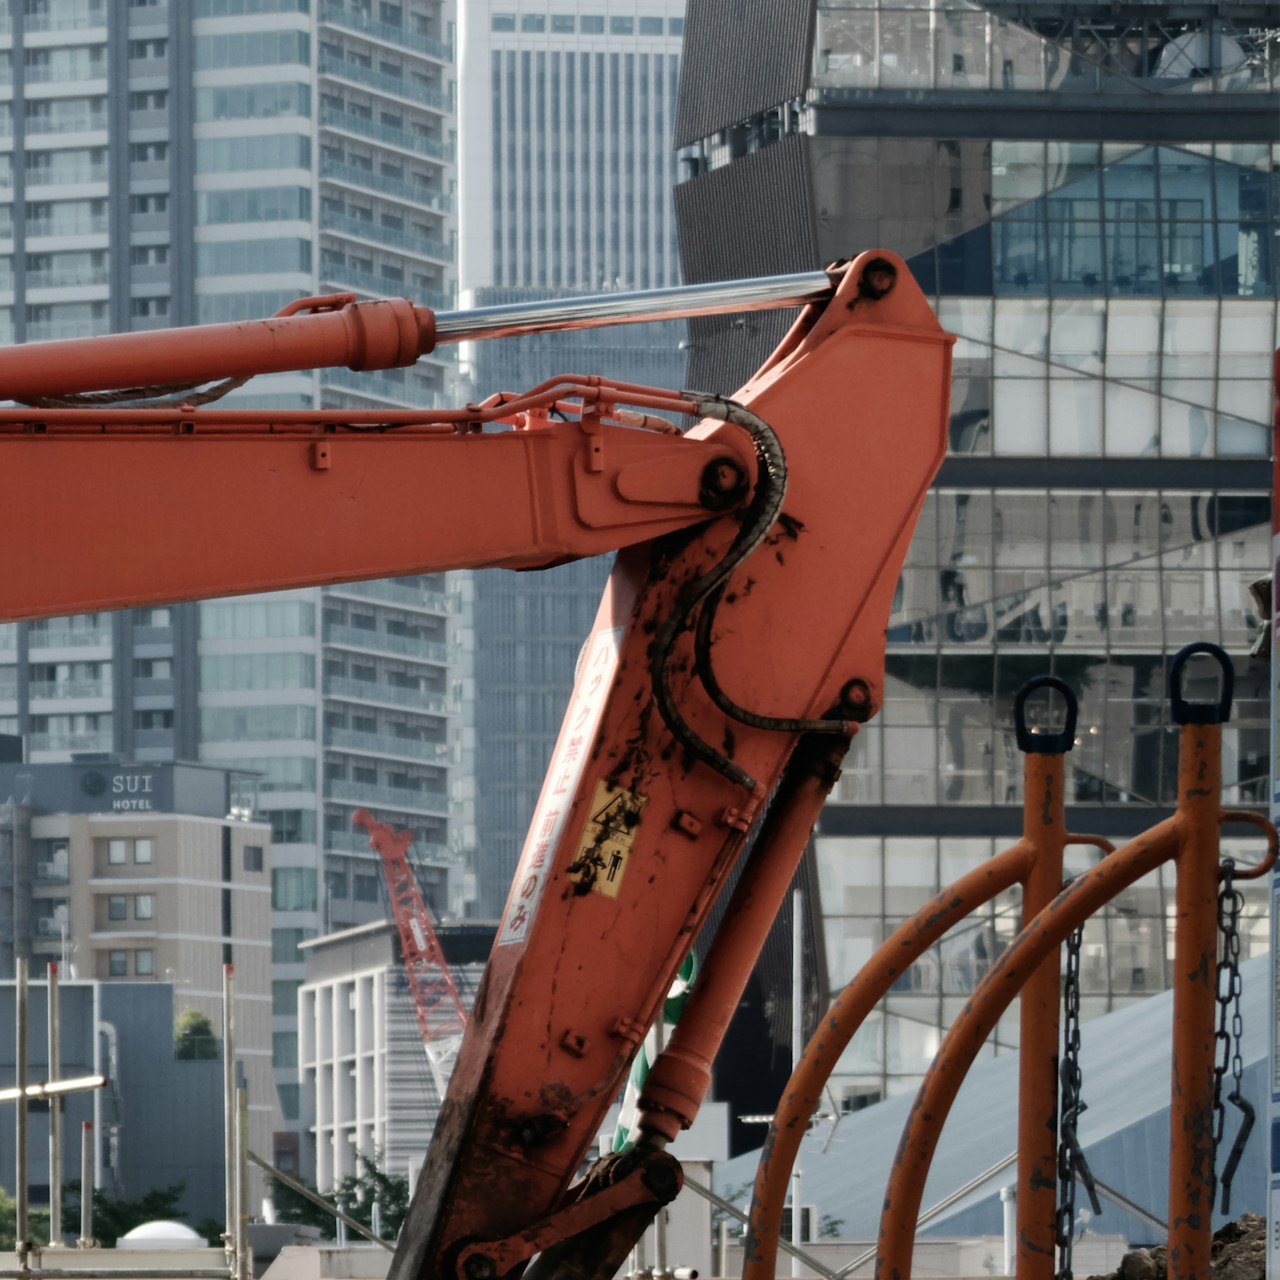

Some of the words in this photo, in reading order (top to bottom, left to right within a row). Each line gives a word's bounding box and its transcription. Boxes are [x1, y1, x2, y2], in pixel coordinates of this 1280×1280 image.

[552, 642, 616, 796] バック禁止
[112, 773, 153, 793] SUI
[112, 799, 152, 810] HOTEL
[508, 809, 560, 933] 前進のみ
